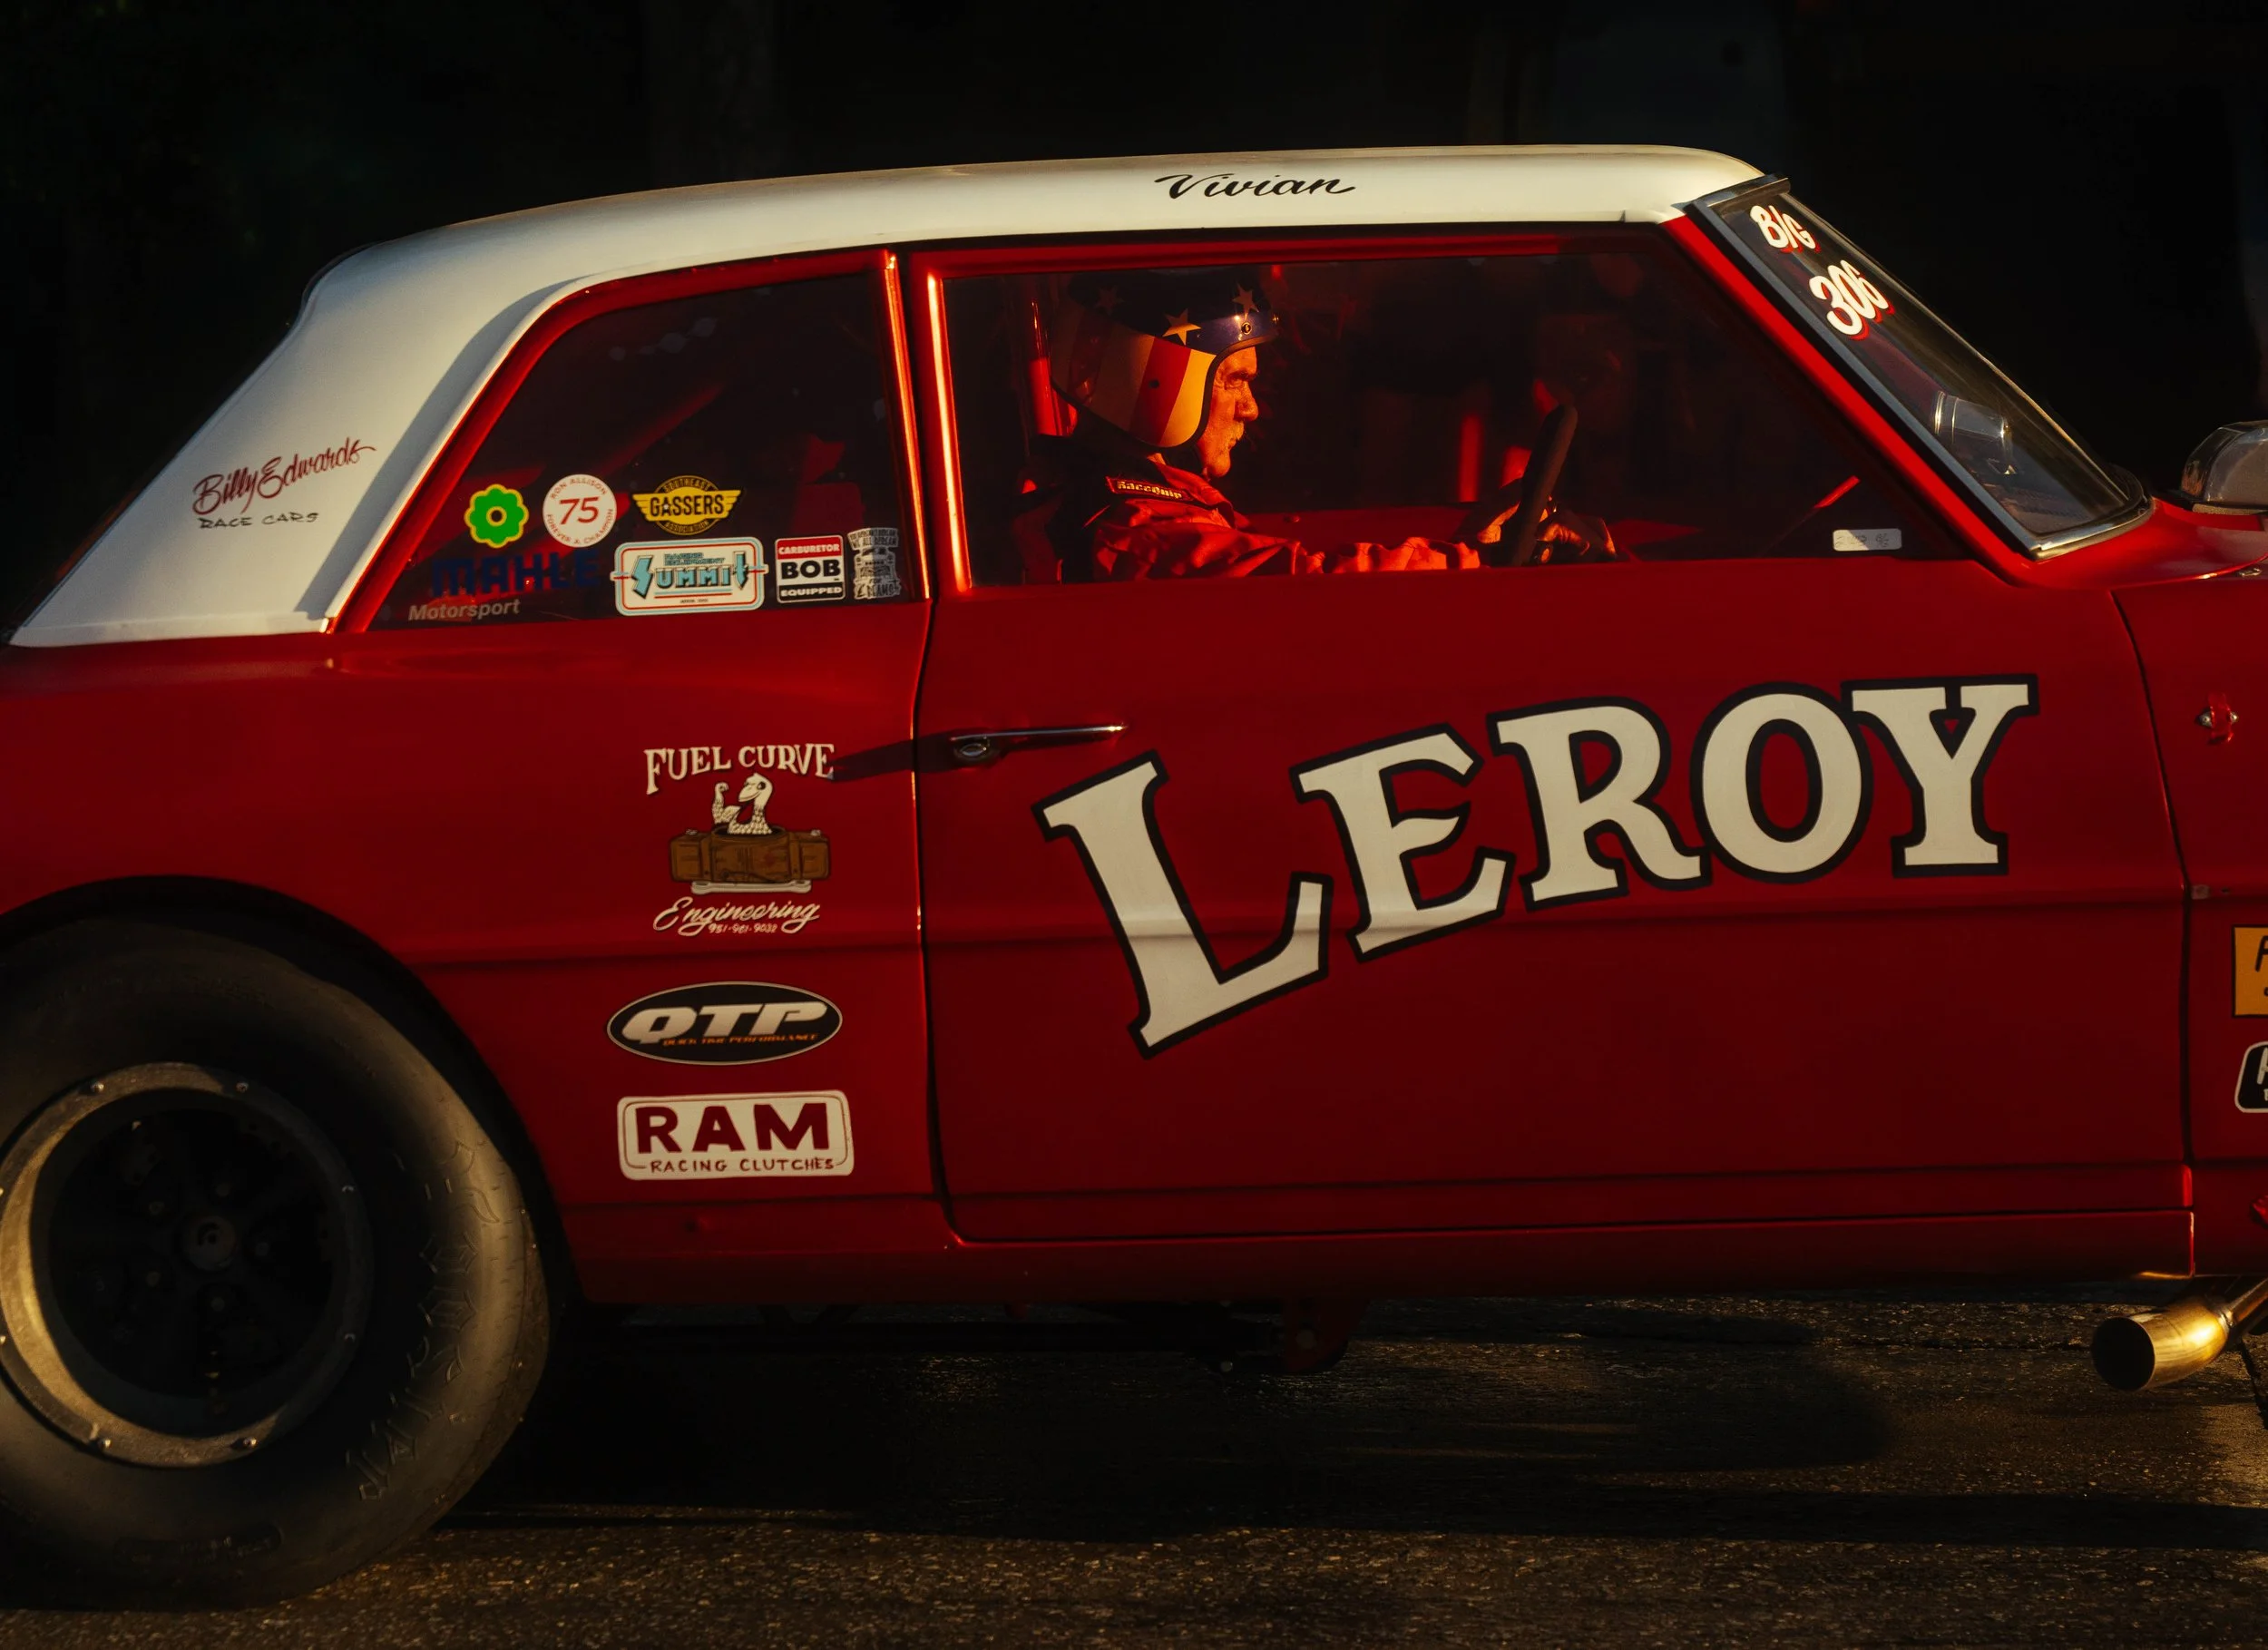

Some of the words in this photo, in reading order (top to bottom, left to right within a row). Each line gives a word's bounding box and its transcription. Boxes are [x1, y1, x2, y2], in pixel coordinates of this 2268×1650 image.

[1154, 172, 1355, 200] Vivian
[1809, 259, 1891, 337] 306
[192, 466, 259, 514] Billy
[258, 437, 376, 499] Edwards
[559, 496, 599, 525] 75
[650, 493, 725, 517] GASSERS
[198, 517, 253, 529] RACE
[262, 512, 319, 525] CARS
[777, 543, 840, 555] CARBURETOR
[431, 548, 601, 598] MAHLE
[780, 559, 841, 580] BOB
[780, 586, 843, 597] EQUIPPED
[408, 598, 521, 621] Motorsport
[643, 746, 732, 796] FUEL
[738, 743, 835, 780] CURVE
[1034, 674, 2036, 1056] LEROY
[652, 895, 821, 937] Engineering
[634, 1102, 830, 1155] RAM
[650, 1159, 728, 1173] RACING
[739, 1157, 835, 1172] CLUTCHES
